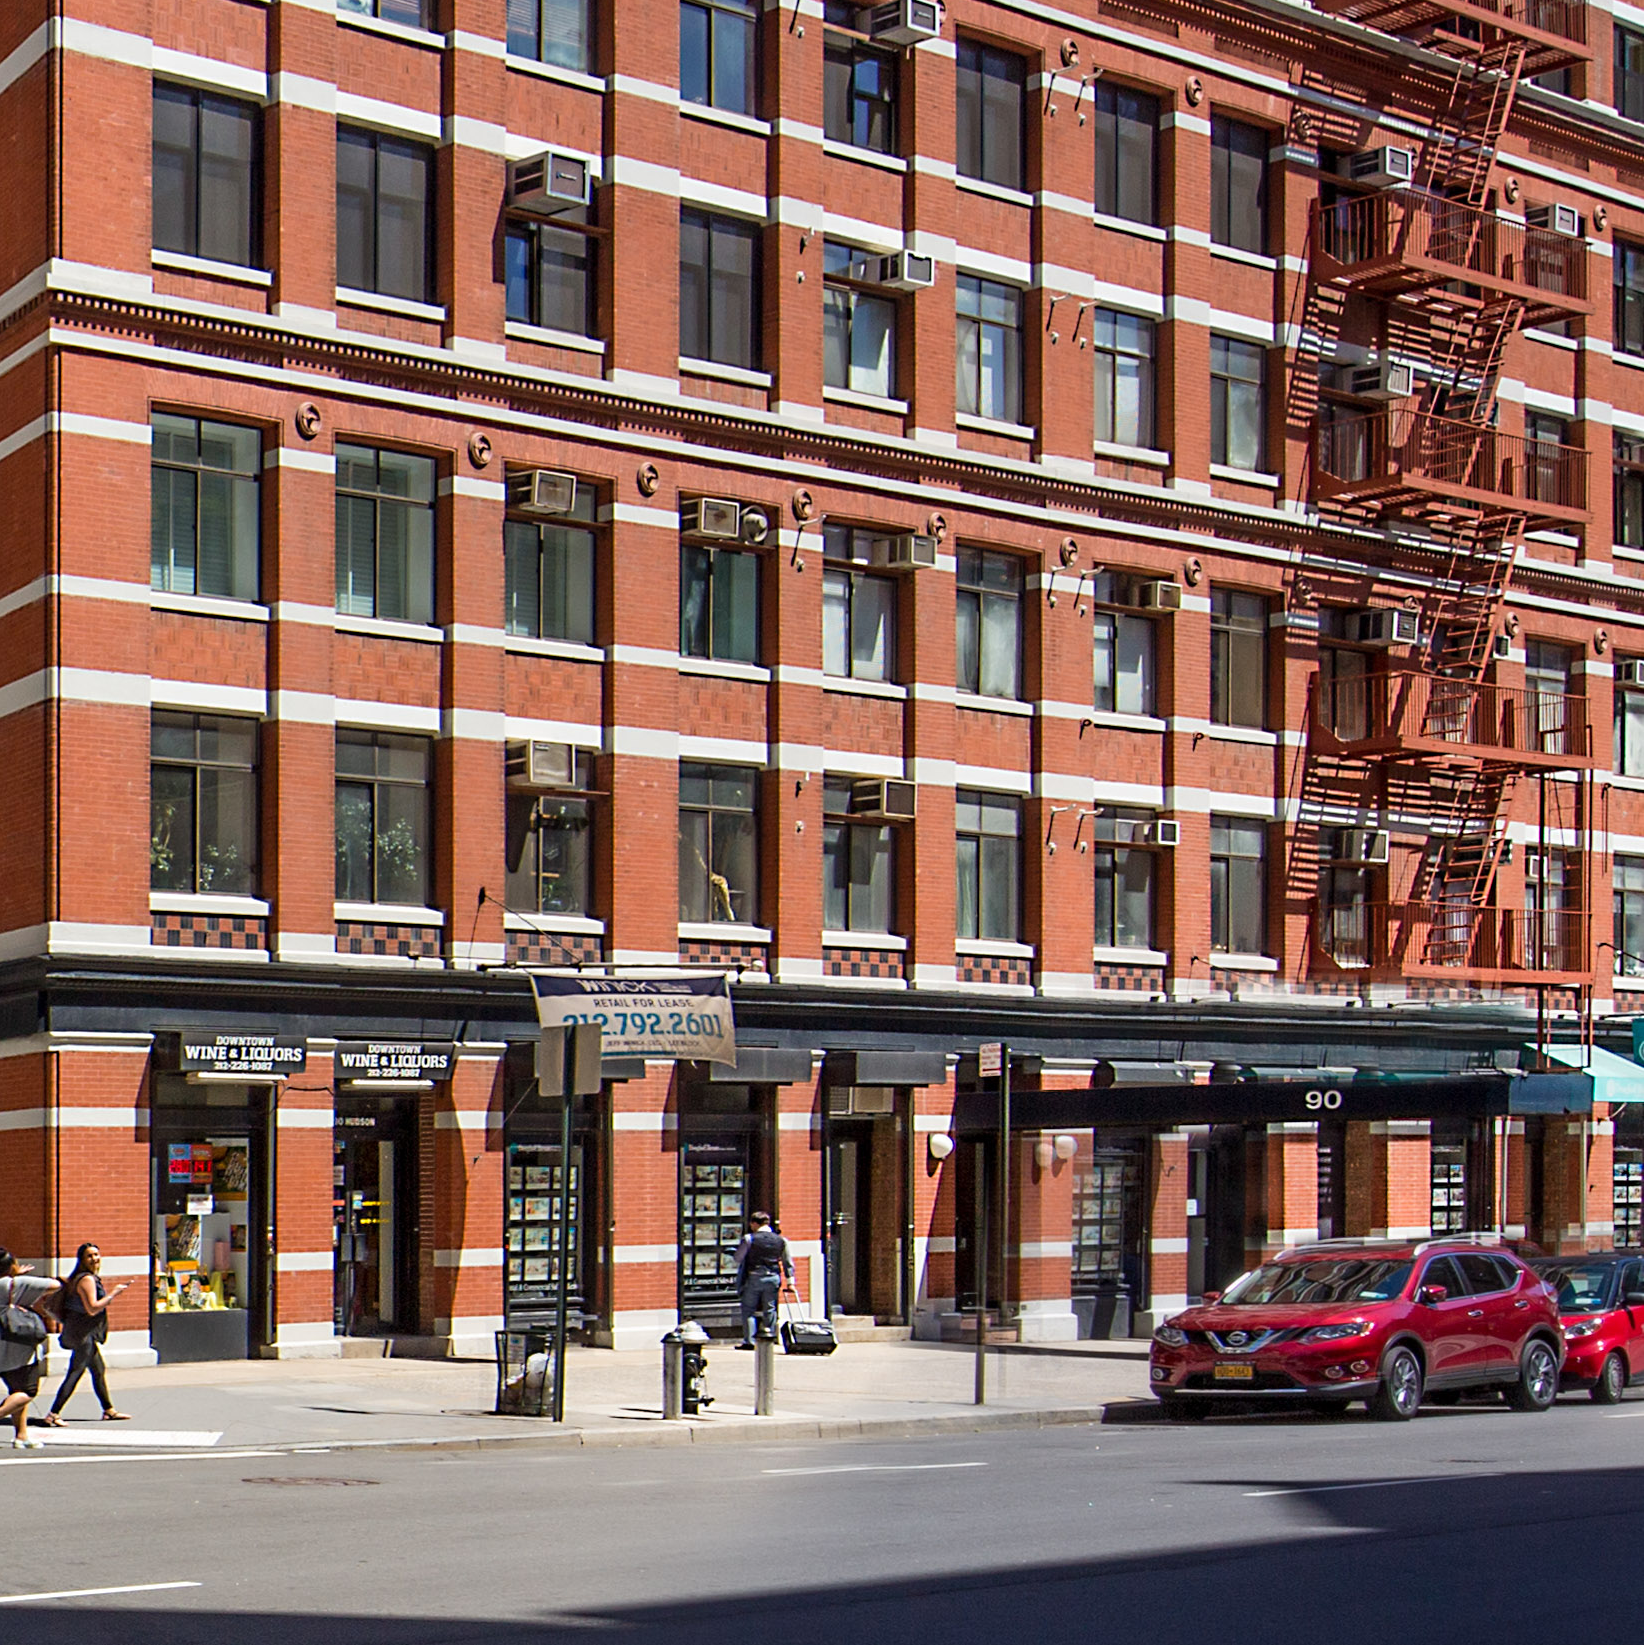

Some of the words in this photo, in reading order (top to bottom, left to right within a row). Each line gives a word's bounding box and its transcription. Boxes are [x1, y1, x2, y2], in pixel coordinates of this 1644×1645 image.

[576, 979, 657, 993] WINICK
[593, 998, 630, 1008] RETAIL
[633, 998, 654, 1008] FOR
[657, 998, 694, 1008] LEASE
[216, 1036, 274, 1046] DOWNTOWN
[185, 1045, 227, 1060] WINE
[229, 1048, 238, 1059] &
[240, 1046, 303, 1062] LIQUORS
[367, 1044, 421, 1054] DOWNTOWN
[341, 1054, 379, 1067] WINE
[380, 1056, 388, 1066] &
[390, 1054, 448, 1068] LIQUORS
[1305, 1090, 1342, 1110] 90
[345, 1117, 376, 1126] HUDSON
